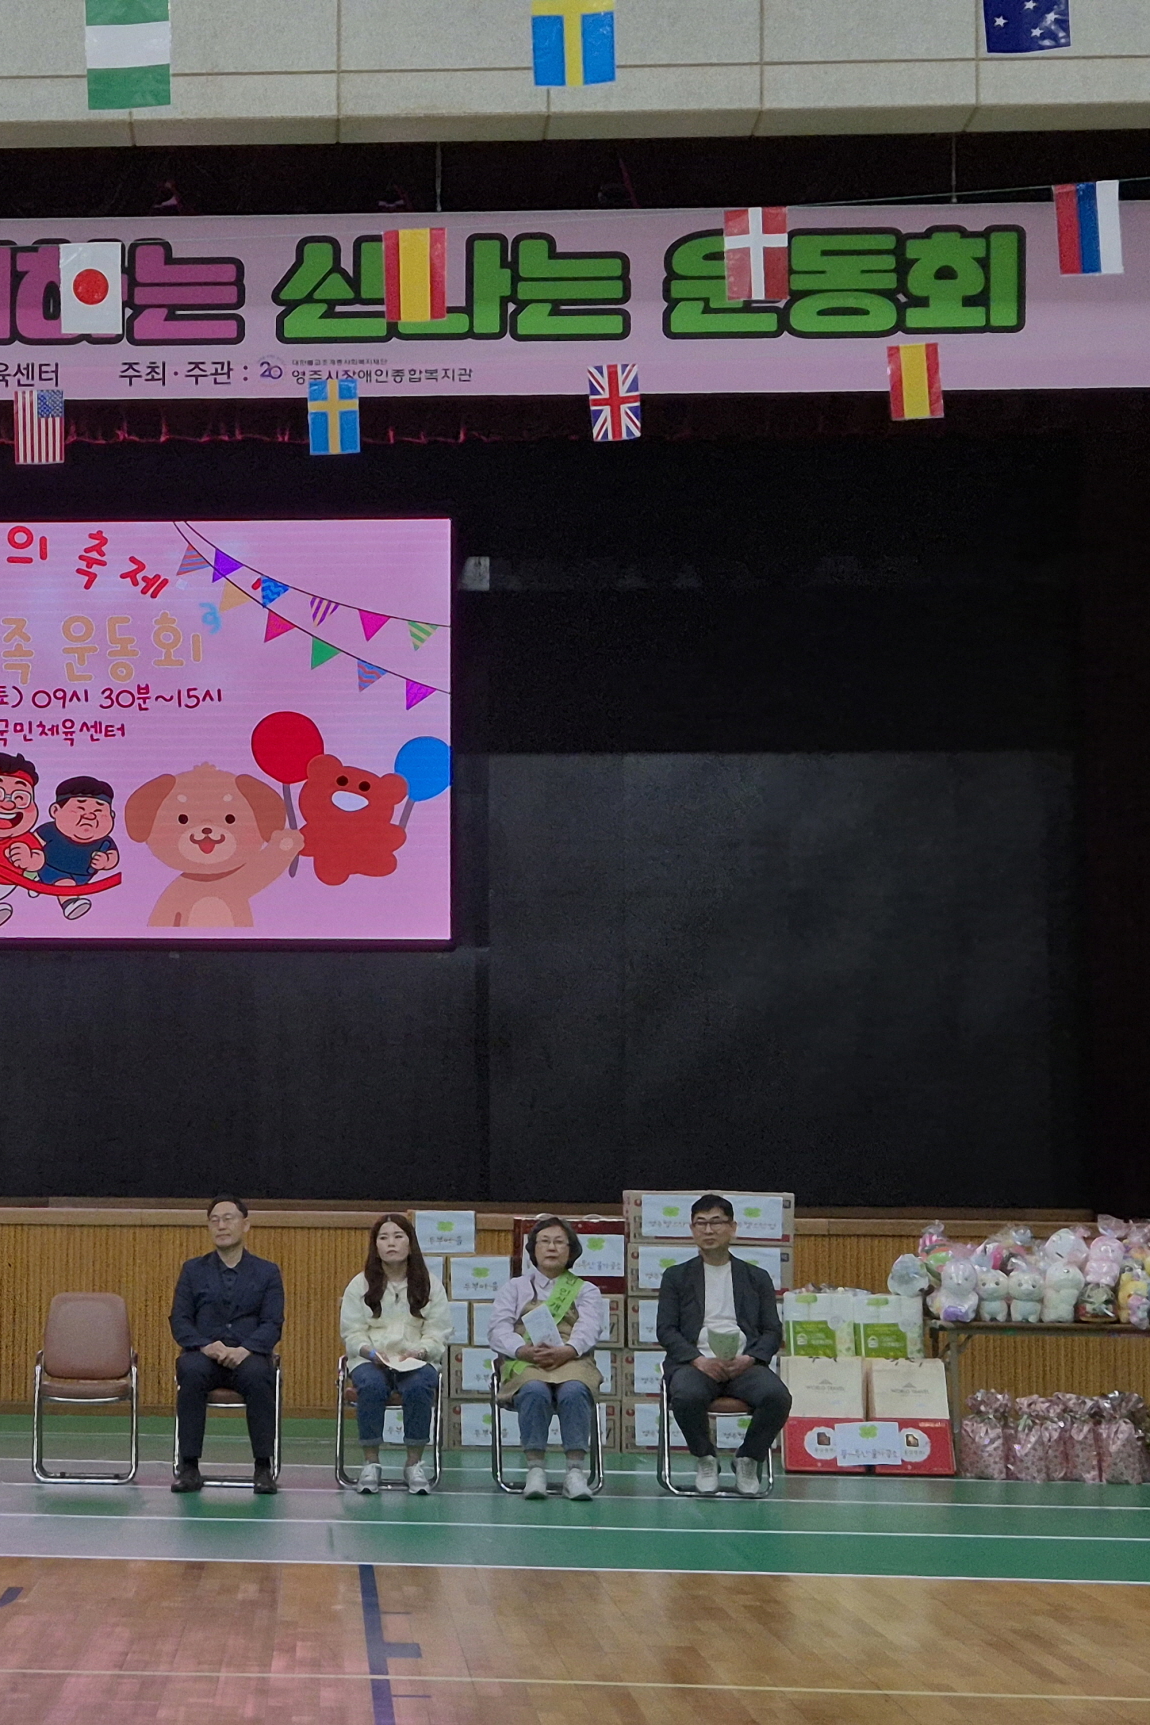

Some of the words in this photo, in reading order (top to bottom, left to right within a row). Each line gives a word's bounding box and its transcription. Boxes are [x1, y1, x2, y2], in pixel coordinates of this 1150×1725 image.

[272, 232, 631, 343] 신나는
[662, 224, 1026, 339] 운동회
[75, 530, 169, 599] 축제
[61, 611, 204, 682] 운동회
[31, 688, 90, 710] 09시
